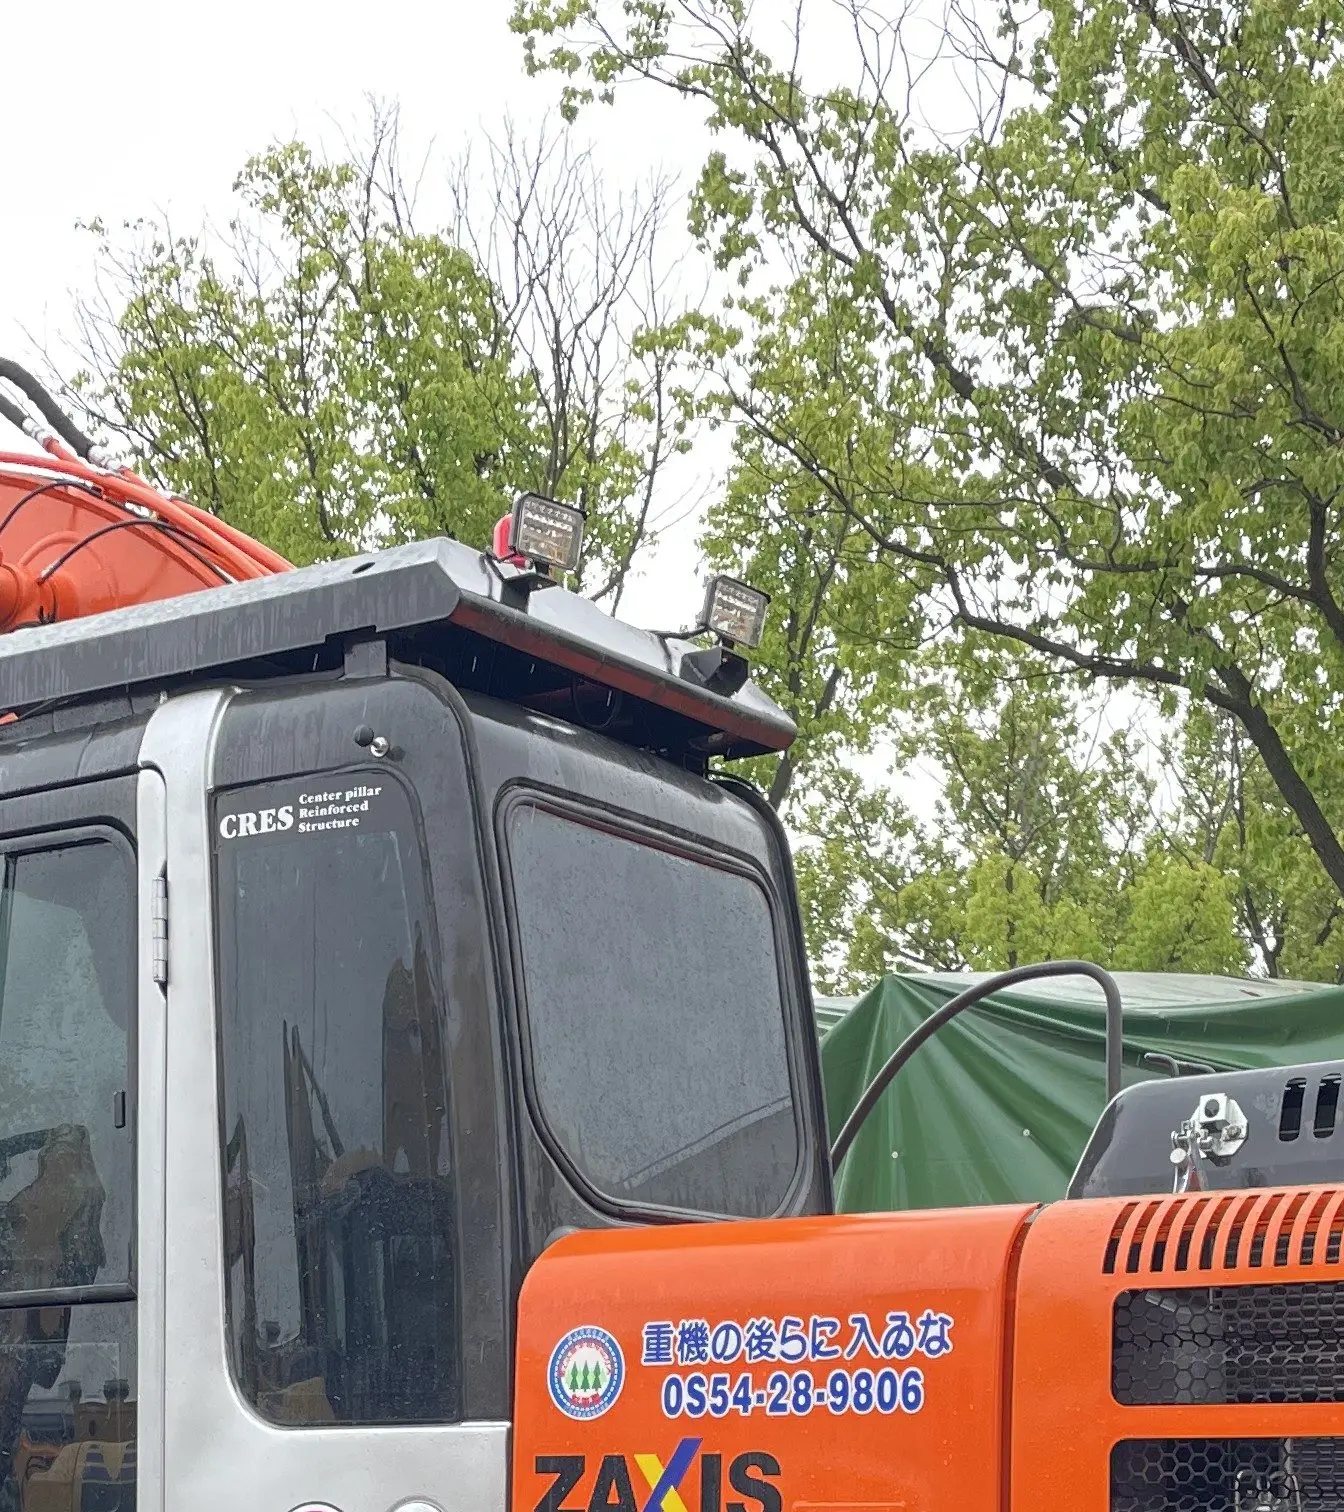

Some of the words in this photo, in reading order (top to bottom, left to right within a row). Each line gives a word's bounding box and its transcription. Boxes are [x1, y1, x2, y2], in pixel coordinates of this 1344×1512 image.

[298, 791, 343, 805] Center
[345, 786, 383, 802] pillar
[298, 800, 370, 819] Reinforced
[219, 805, 294, 839] CRES
[298, 817, 360, 833] Structure
